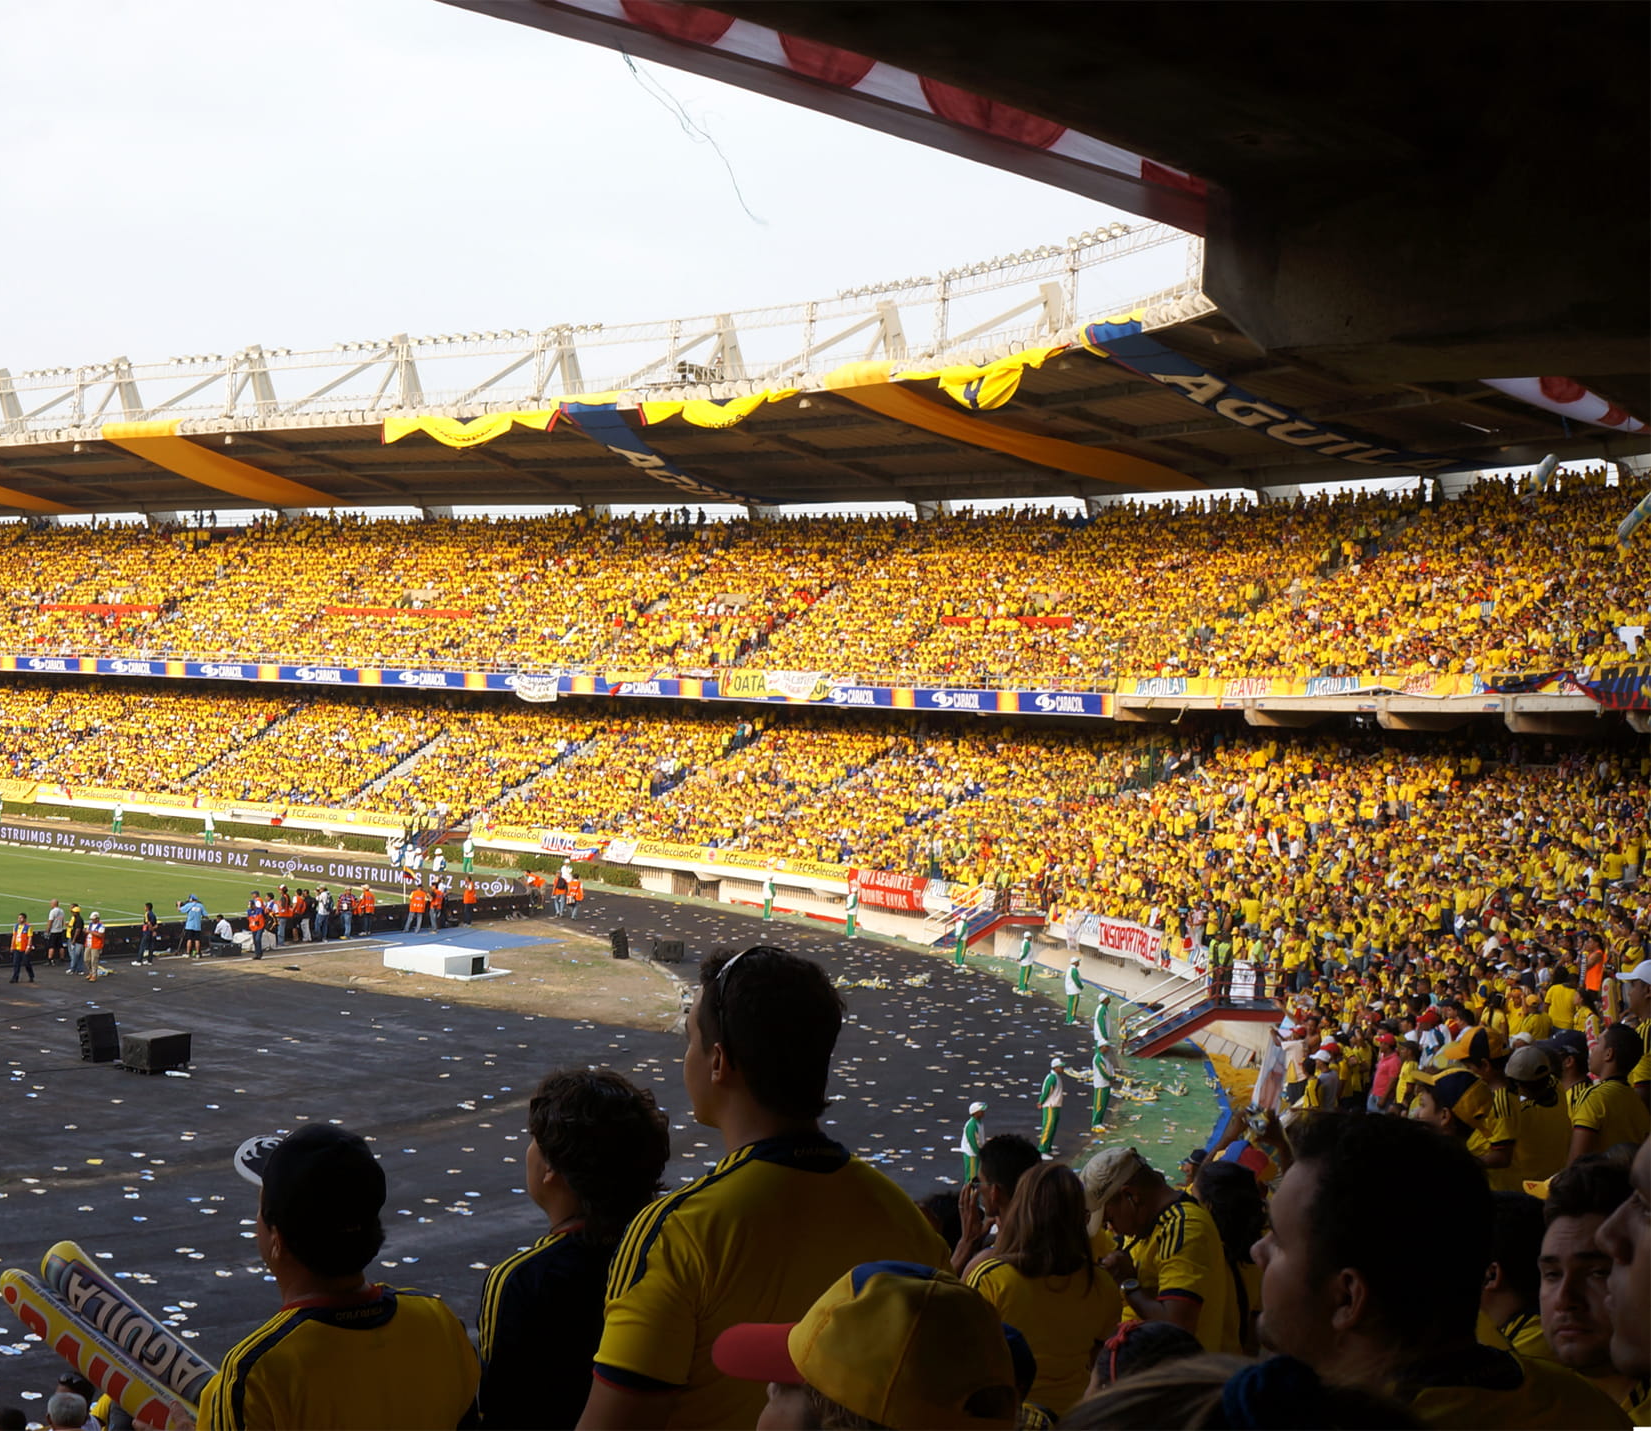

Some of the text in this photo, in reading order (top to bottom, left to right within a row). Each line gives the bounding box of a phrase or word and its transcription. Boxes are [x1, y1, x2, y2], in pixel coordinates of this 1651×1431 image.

[1149, 373, 1463, 470] AGUILA
[45, 660, 68, 671] CARACOL
[128, 661, 151, 674] CARACOL
[218, 664, 243, 678] CARACOL
[315, 667, 342, 682] CARACOL
[419, 672, 447, 686] CARACOL
[1142, 678, 1179, 696] AGUILA
[848, 689, 875, 705] CARACOL
[953, 693, 980, 709] CARACOL
[1055, 694, 1085, 713] CARACOL
[144, 793, 186, 807] FCF.com.co
[292, 807, 338, 821] FCF.com.co
[56, 834, 76, 847] PAZ
[80, 838, 249, 867] PASO PASO CONSTRUIMOS PAZ
[724, 852, 770, 868] FCF.com.co
[259, 858, 285, 869] PASO
[296, 861, 324, 873] PASO
[68, 1272, 211, 1396] AGUILA
